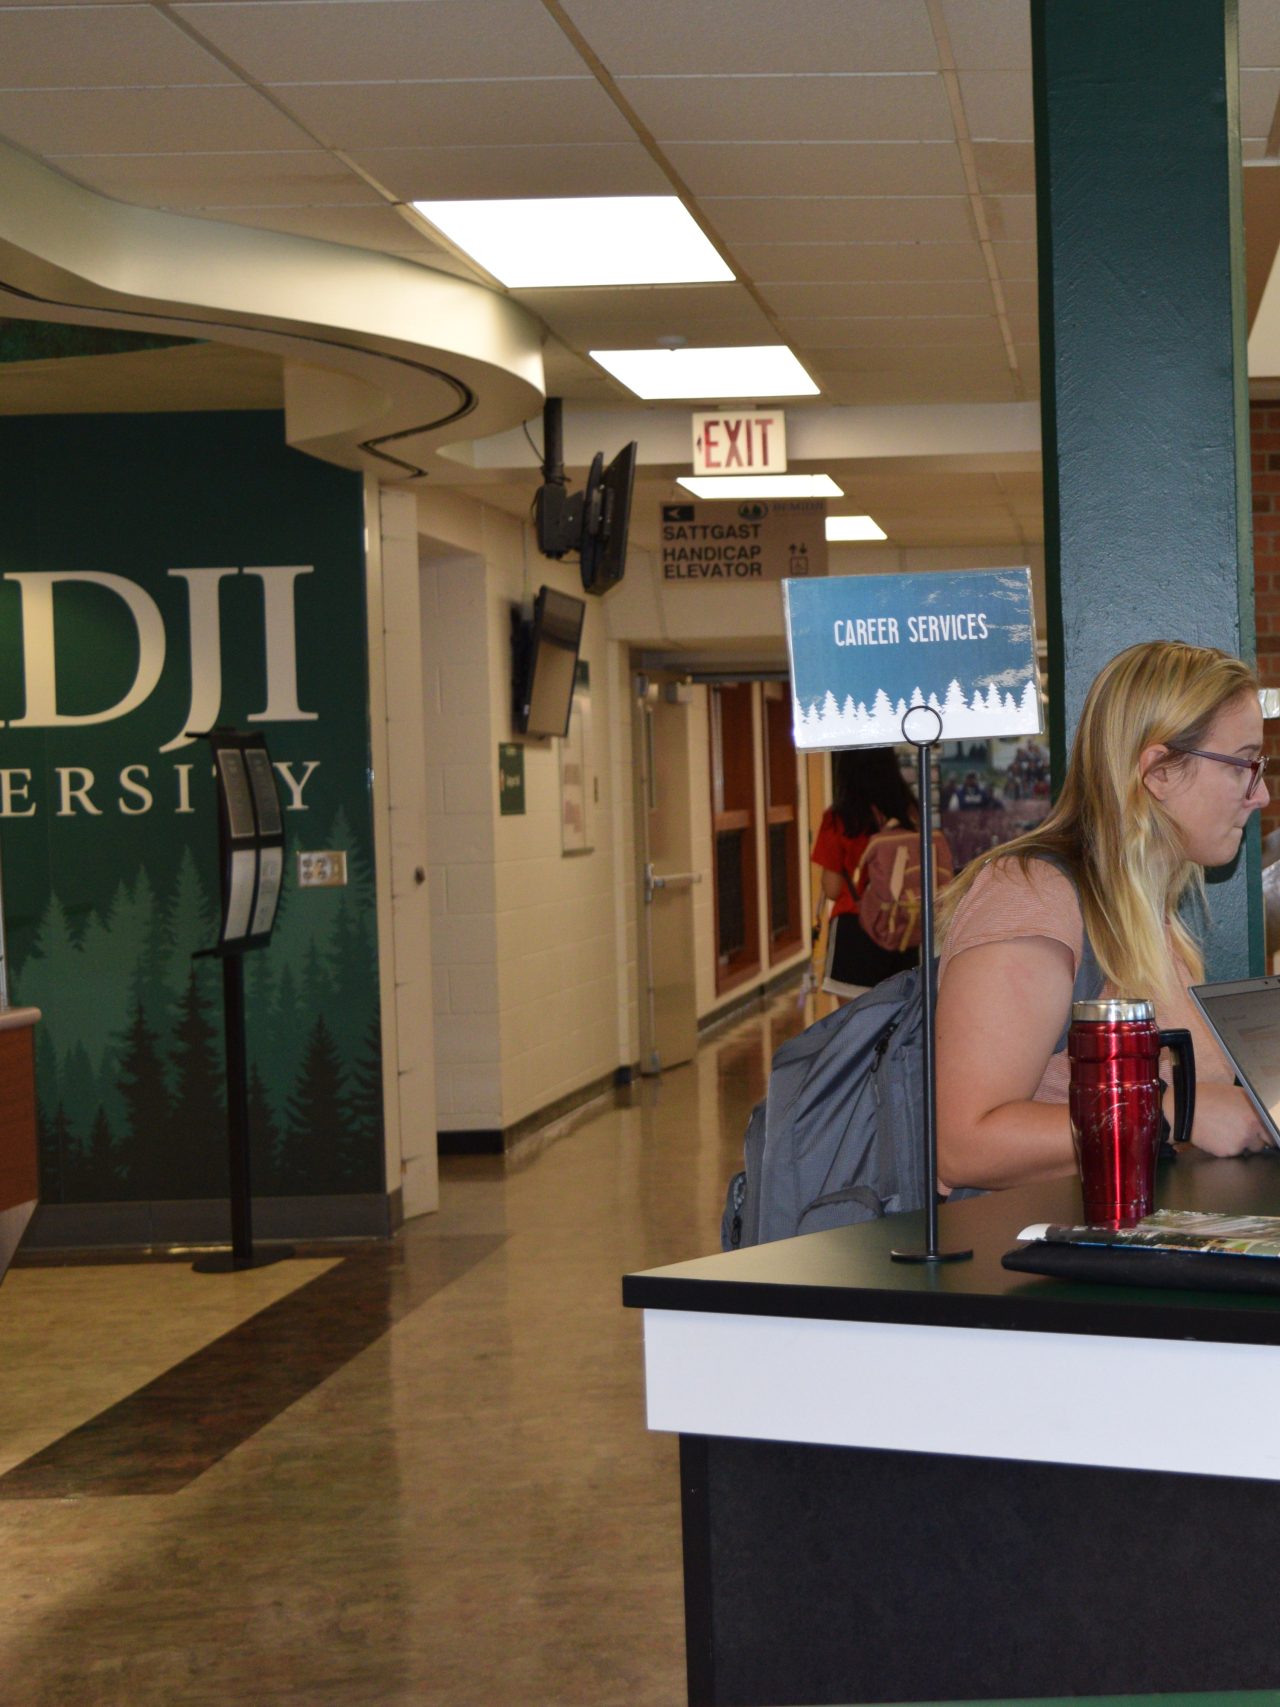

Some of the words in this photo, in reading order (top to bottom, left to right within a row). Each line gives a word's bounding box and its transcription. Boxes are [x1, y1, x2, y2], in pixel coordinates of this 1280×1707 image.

[703, 418, 774, 468] EXIT
[662, 524, 762, 541] SATTGAST
[663, 545, 762, 562] HANDICAP
[664, 562, 763, 579] ELEVATOR
[834, 617, 899, 647] CAREER
[907, 613, 989, 643] SERVICES
[0, 565, 320, 754] DJI
[0, 760, 320, 817] ERSIY
